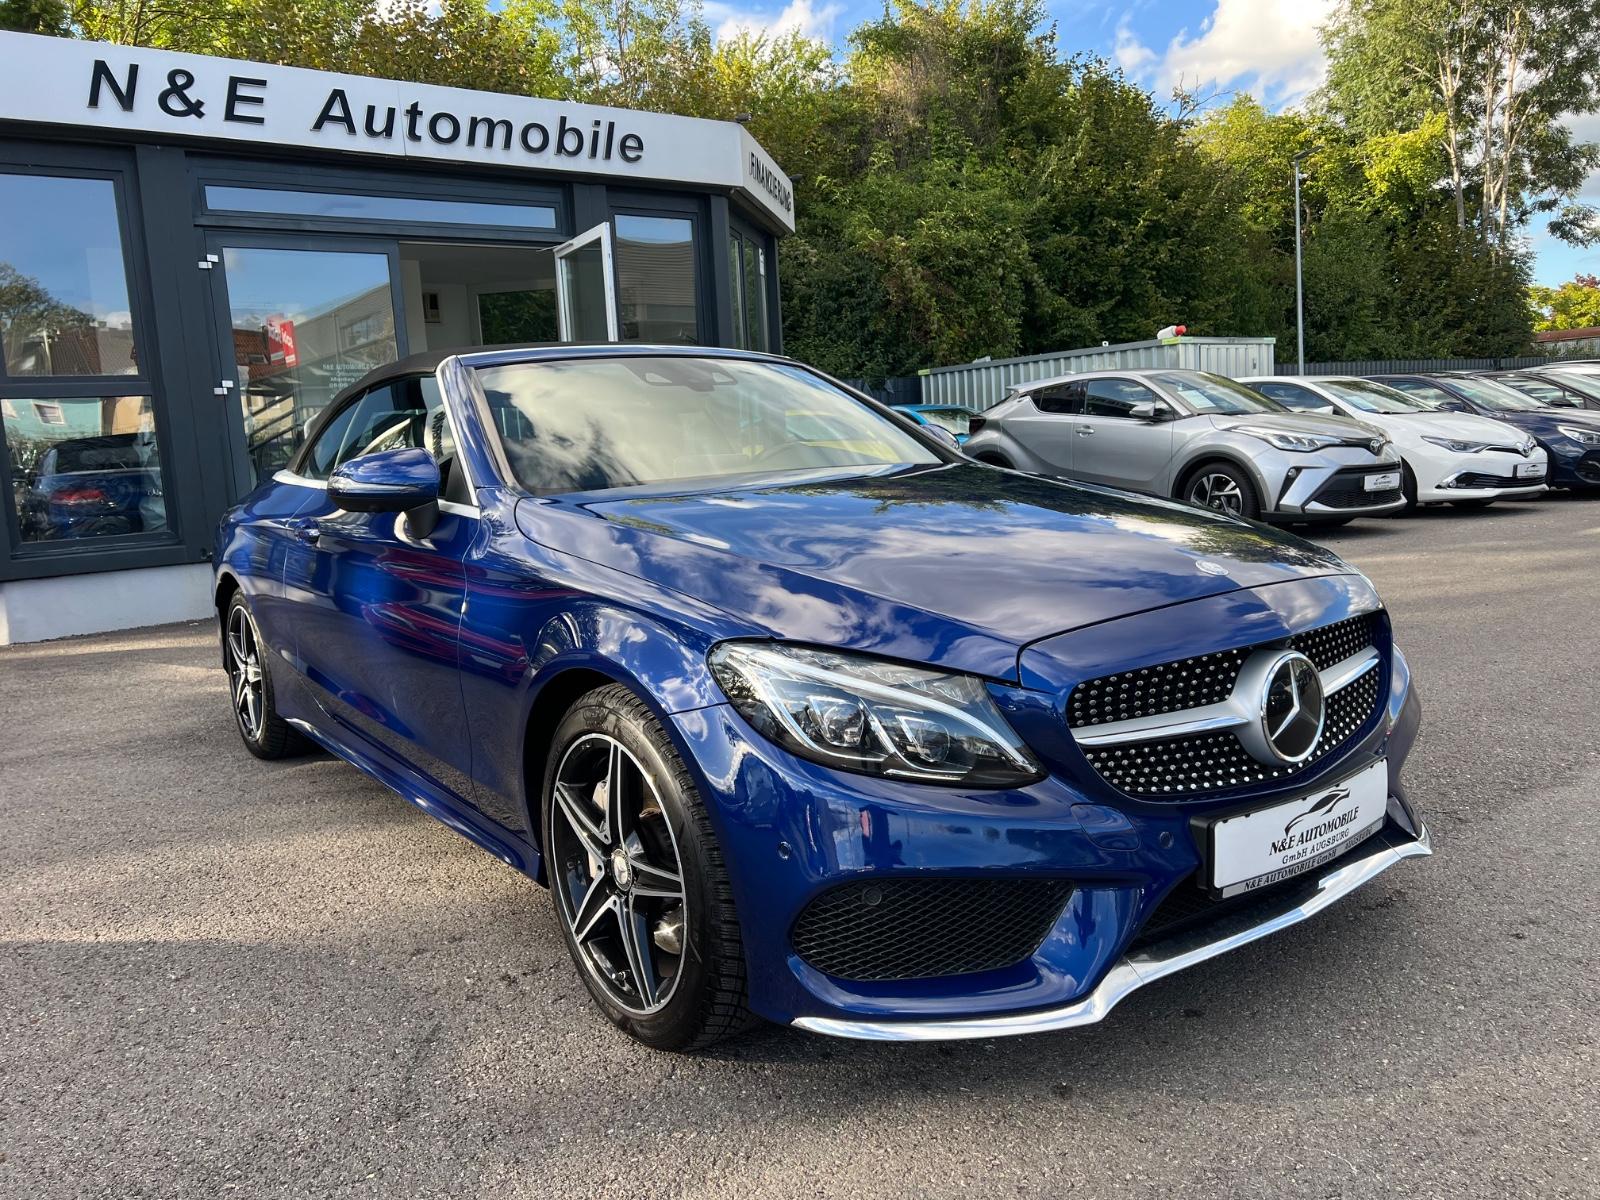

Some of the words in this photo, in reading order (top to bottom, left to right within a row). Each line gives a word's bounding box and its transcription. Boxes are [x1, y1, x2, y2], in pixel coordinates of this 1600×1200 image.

[310, 89, 645, 163] Automobile
[749, 151, 792, 212] FINANZIERUNG
[1244, 874, 1264, 892] N&E
[1264, 859, 1316, 884] AUTOMOBILE
[1317, 848, 1337, 865] GmbH
[1345, 826, 1373, 849] AUGSBURG
[1269, 835, 1295, 856] N&E
[1296, 806, 1360, 847] AUTOMOBILE
[1282, 847, 1308, 865] GmbH
[1310, 828, 1350, 855] AUGSBURG
